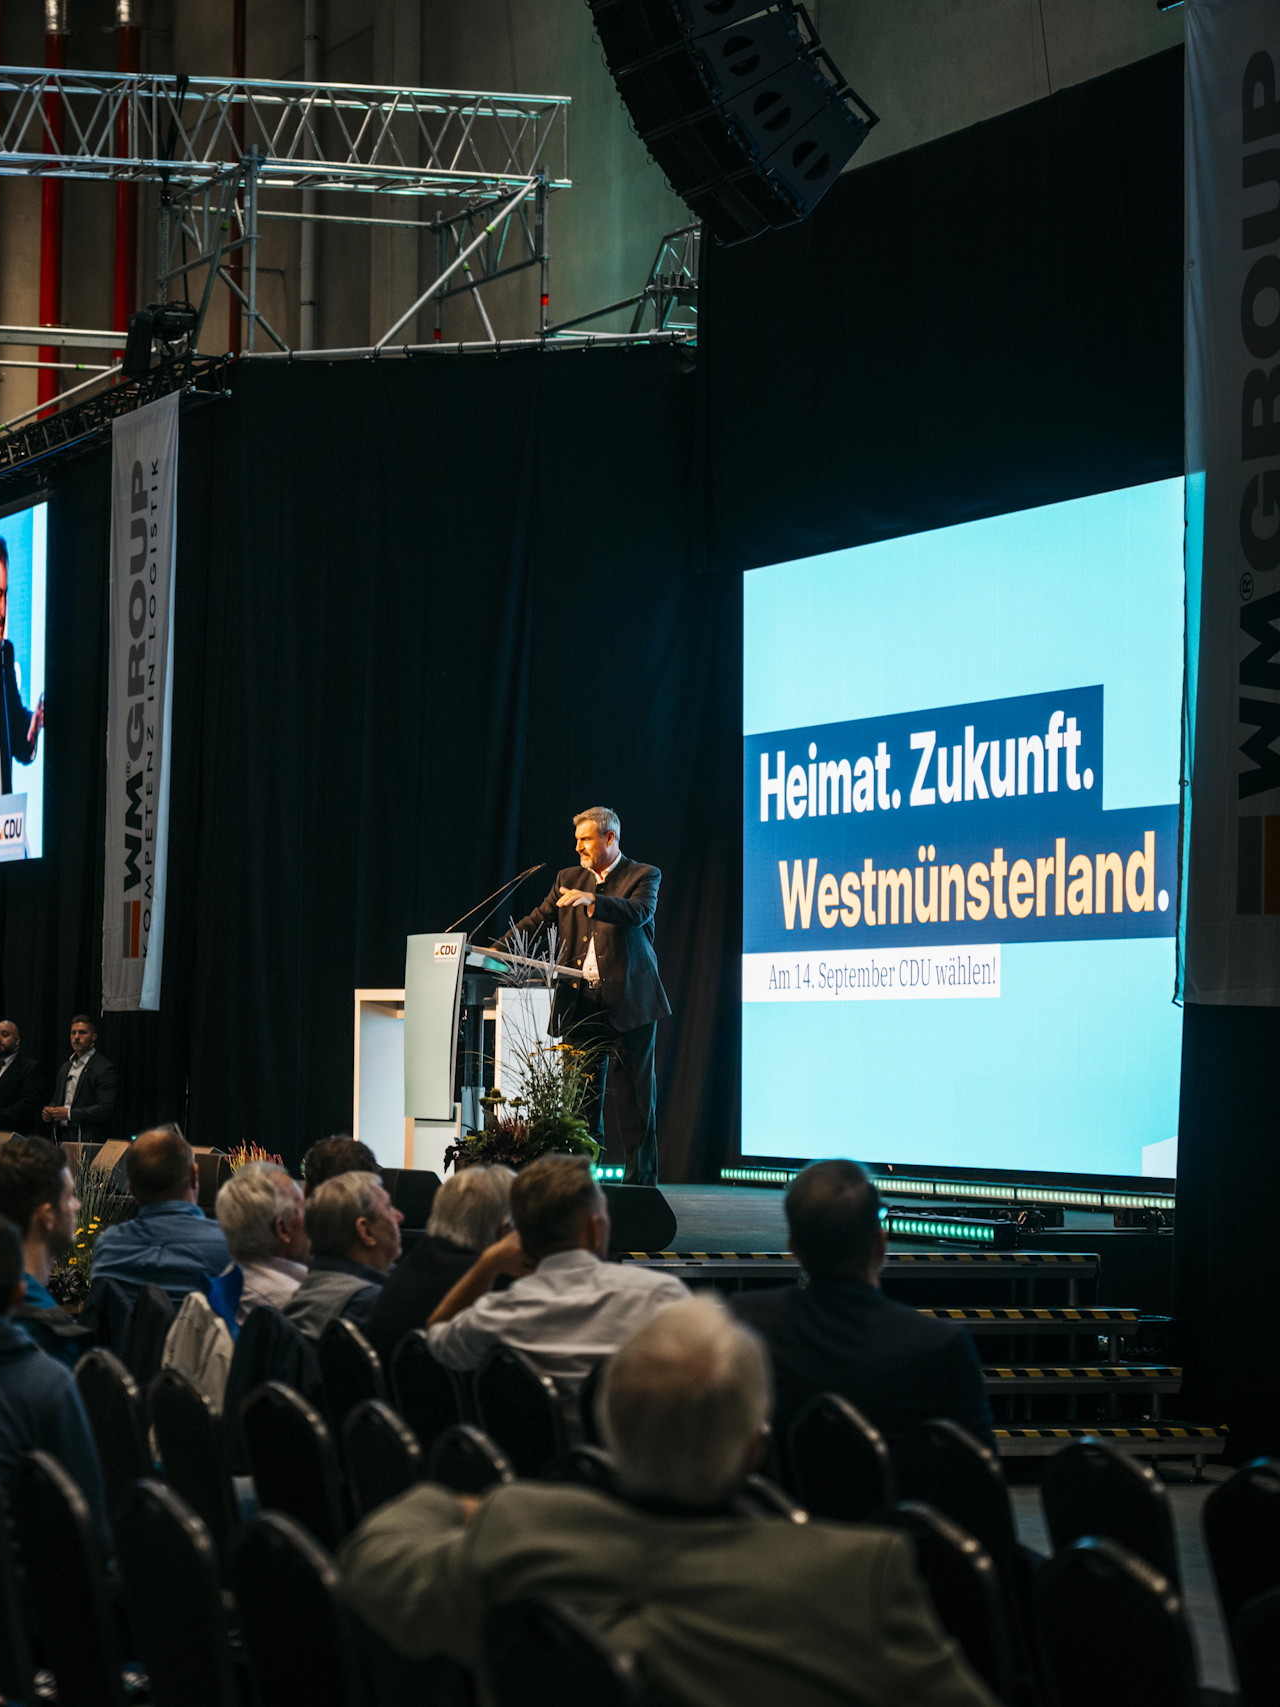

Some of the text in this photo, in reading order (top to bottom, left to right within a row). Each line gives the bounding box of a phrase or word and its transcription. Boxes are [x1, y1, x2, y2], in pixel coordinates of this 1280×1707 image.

[148, 458, 159, 640] LOGISTIK
[760, 710, 1094, 822] Heimat. Zukunft.
[4, 818, 22, 839] CDU
[778, 830, 1170, 931] Westmünsterland.
[440, 945, 457, 955] CDU
[768, 955, 997, 996] Am 14. September CDU wählen!
